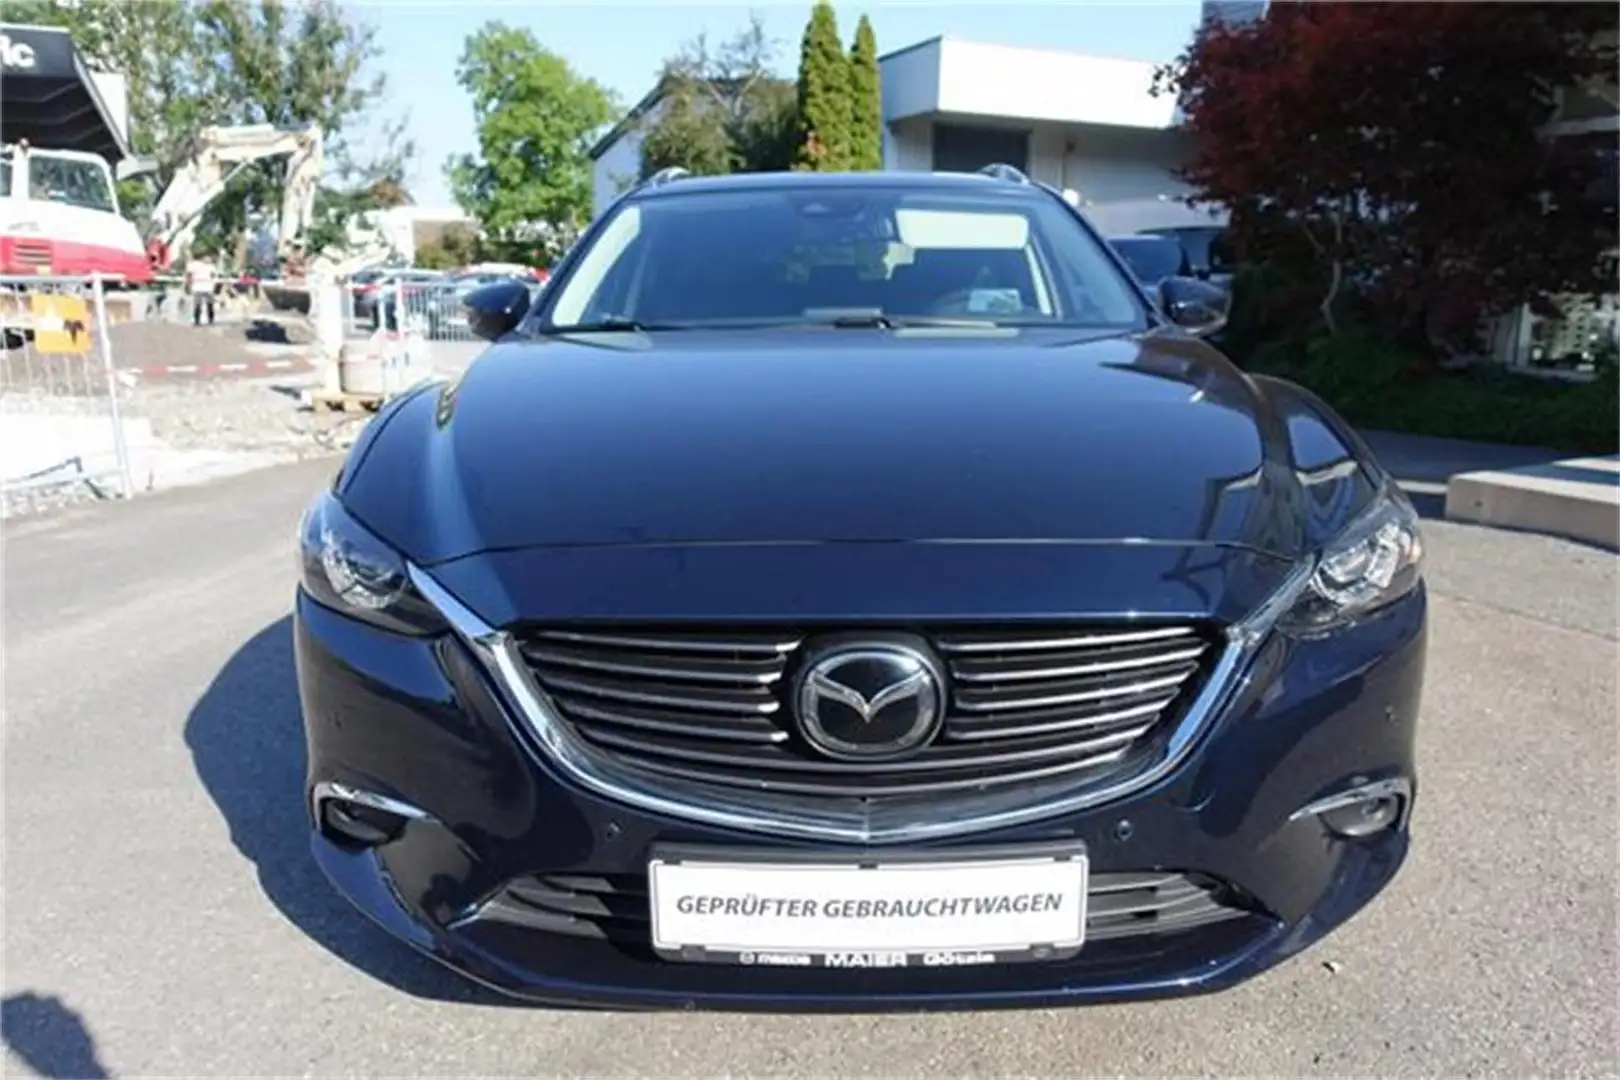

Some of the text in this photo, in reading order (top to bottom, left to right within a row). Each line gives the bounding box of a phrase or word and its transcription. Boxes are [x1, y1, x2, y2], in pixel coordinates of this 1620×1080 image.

[676, 893, 1063, 919] GEPRÜFTER GEBRAUCHTWAGEN
[824, 952, 908, 968] MAIER
